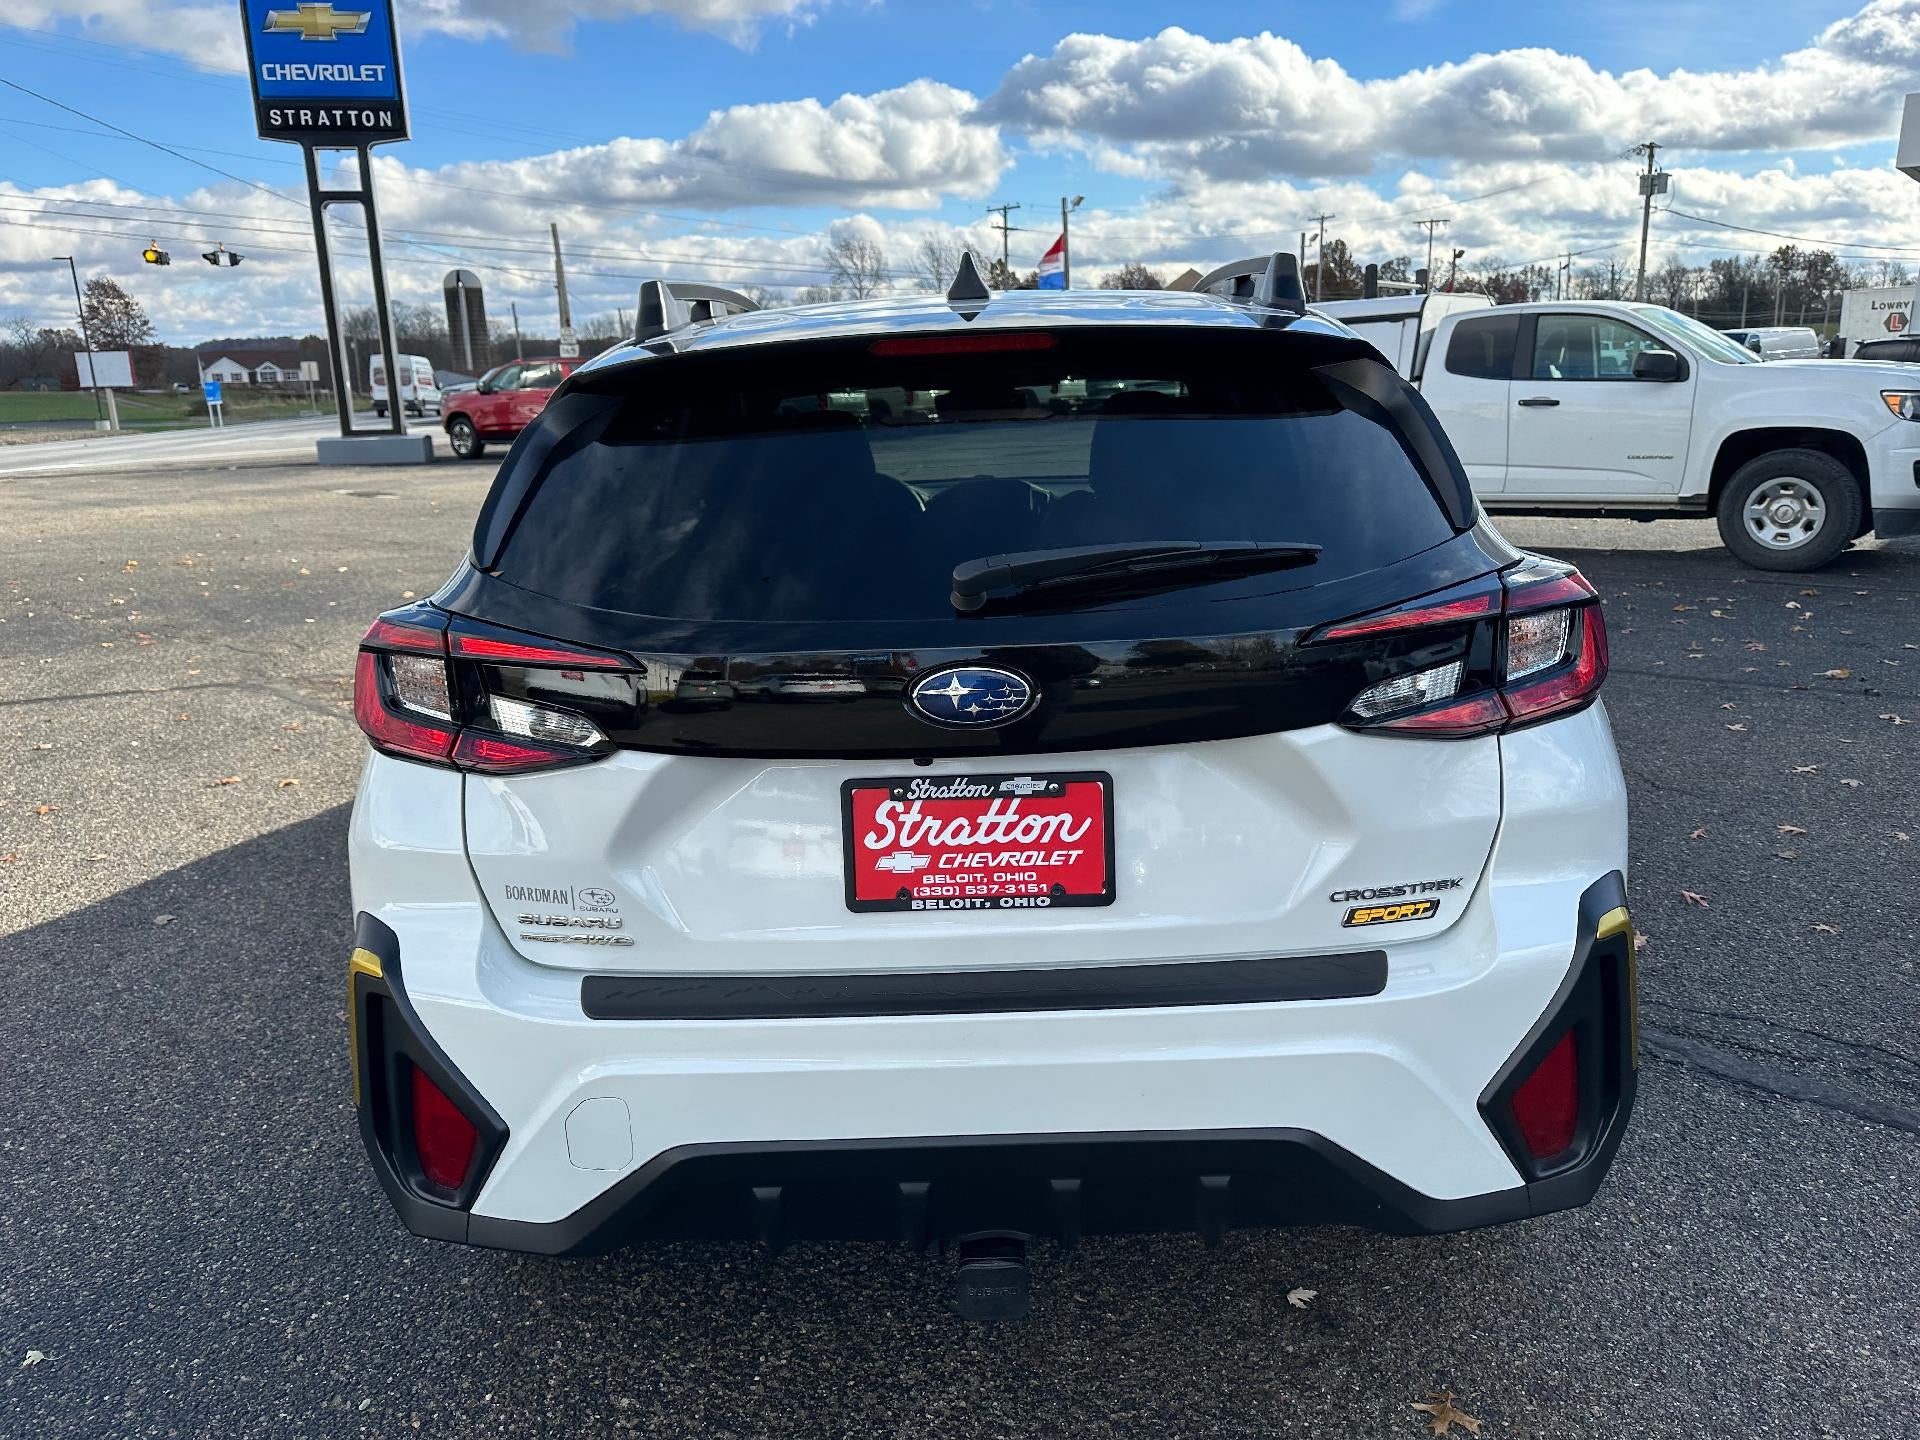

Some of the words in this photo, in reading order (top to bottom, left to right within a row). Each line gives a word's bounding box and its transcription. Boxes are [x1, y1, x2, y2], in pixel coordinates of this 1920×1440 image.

[261, 63, 386, 82] CHEVROLET
[269, 109, 393, 127] STRATTON
[1890, 313, 1902, 331] L
[906, 777, 994, 800] Stratton
[863, 797, 1093, 850] Stratton
[938, 850, 1084, 869] CHEVROLET
[922, 873, 988, 884] BELOIT,
[993, 871, 1037, 882] OHIO
[505, 885, 569, 905] BOARDMAN
[913, 886, 960, 897] (330)
[965, 883, 1048, 896] 537-3151
[1329, 877, 1464, 902] CROSSTREK
[579, 906, 619, 914] SUBARU
[911, 898, 991, 910] BELOIT,
[999, 896, 1051, 907] OHIO
[518, 913, 623, 929] SUBARU
[1351, 902, 1431, 924] SPORT
